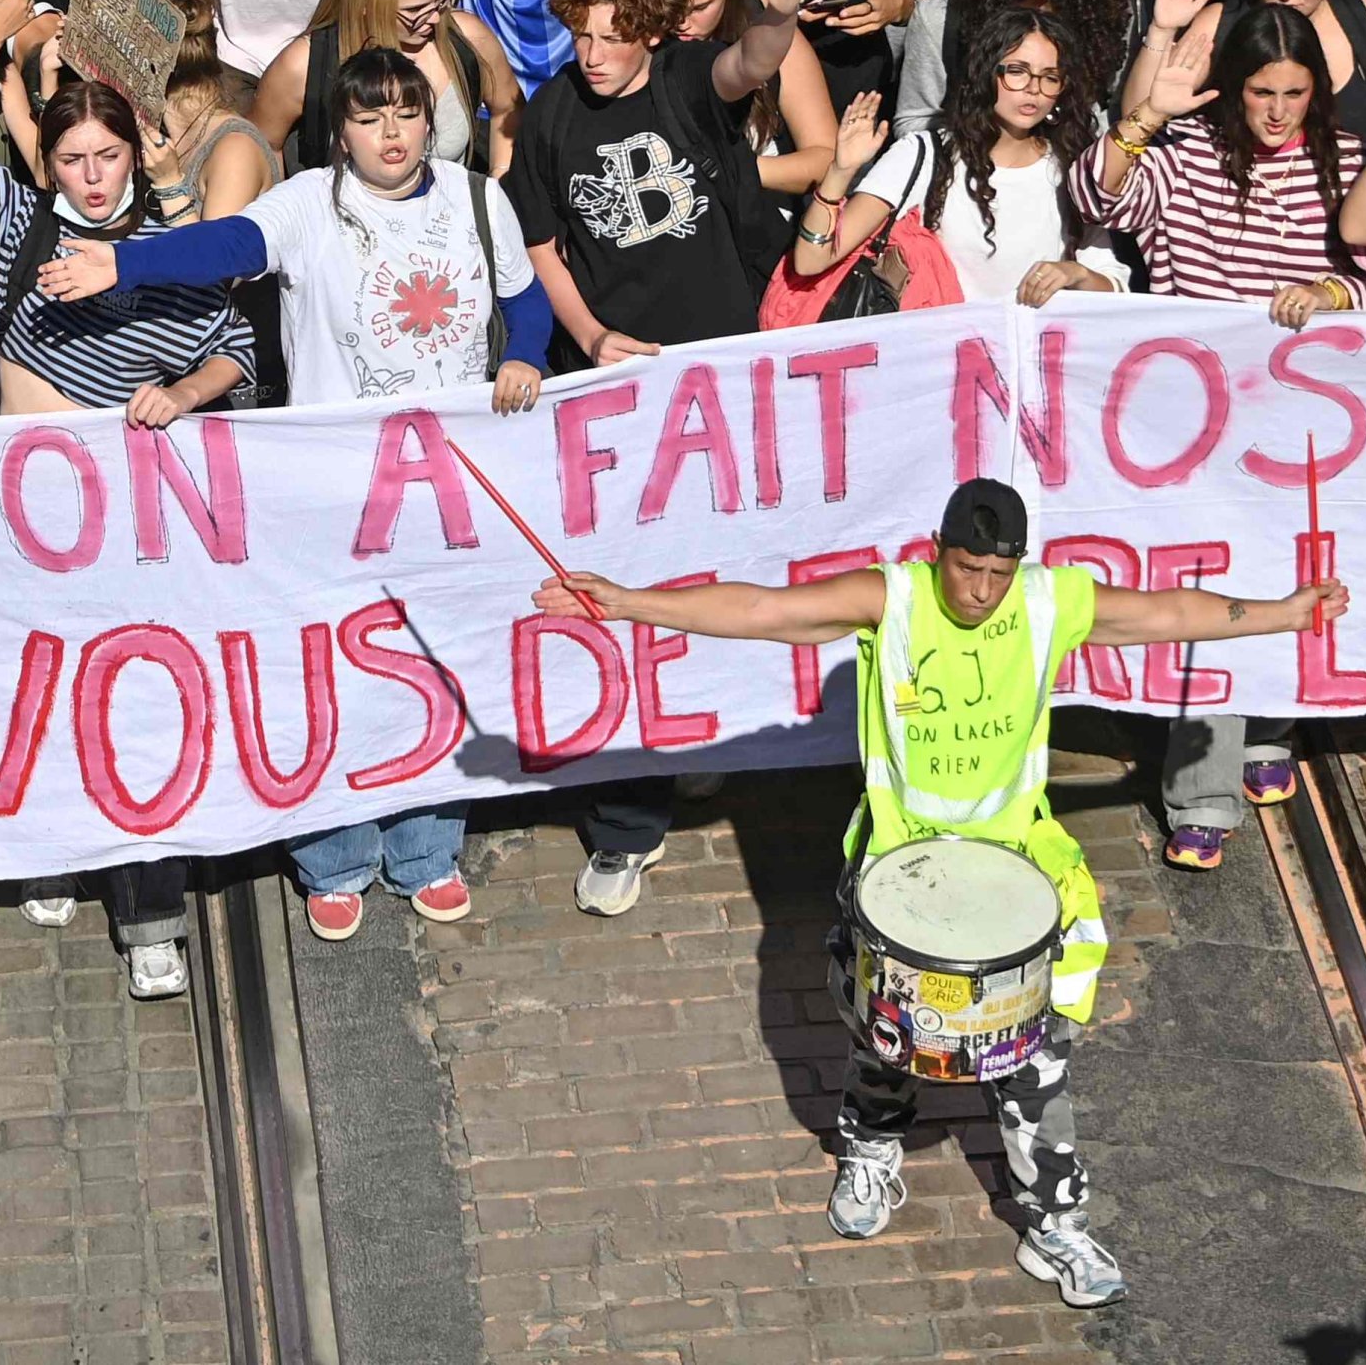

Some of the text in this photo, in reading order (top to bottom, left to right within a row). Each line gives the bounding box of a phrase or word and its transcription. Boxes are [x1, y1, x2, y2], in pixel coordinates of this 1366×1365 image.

[369, 260, 397, 298] HOT
[408, 251, 462, 281] CHILI
[371, 311, 400, 350] RED
[413, 297, 477, 360] PEPPERS
[351, 407, 480, 561] A
[551, 341, 880, 540] FAIT
[511, 570, 722, 776] DE
[907, 724, 938, 745] ON
[930, 754, 982, 776] RIEN
[898, 853, 932, 872] EVANS
[926, 975, 953, 990] OUI
[935, 990, 962, 1005] RIC
